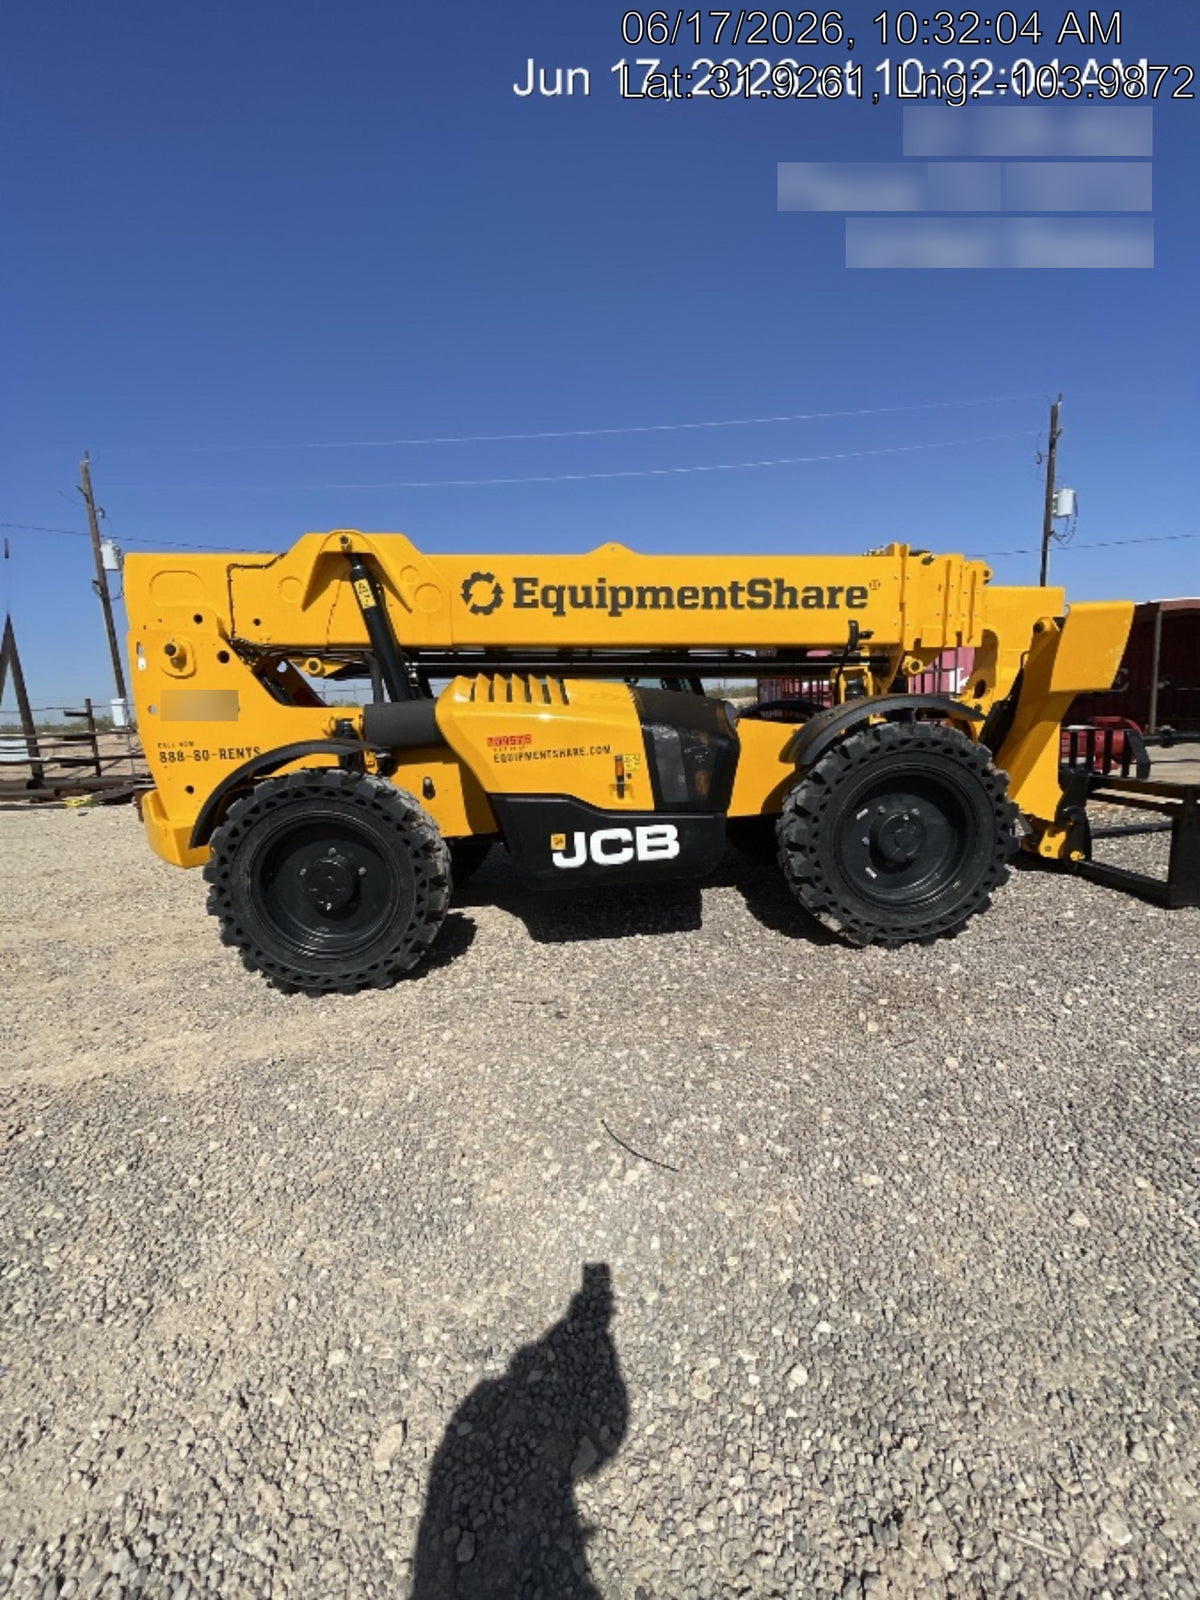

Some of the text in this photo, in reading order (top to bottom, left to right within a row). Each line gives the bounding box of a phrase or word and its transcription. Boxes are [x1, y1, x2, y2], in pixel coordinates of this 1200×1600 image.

[512, 576, 868, 617] EquipmentShare
[494, 745, 611, 763] EQUIPMENTSHARE.COM
[550, 824, 681, 869] JCB
